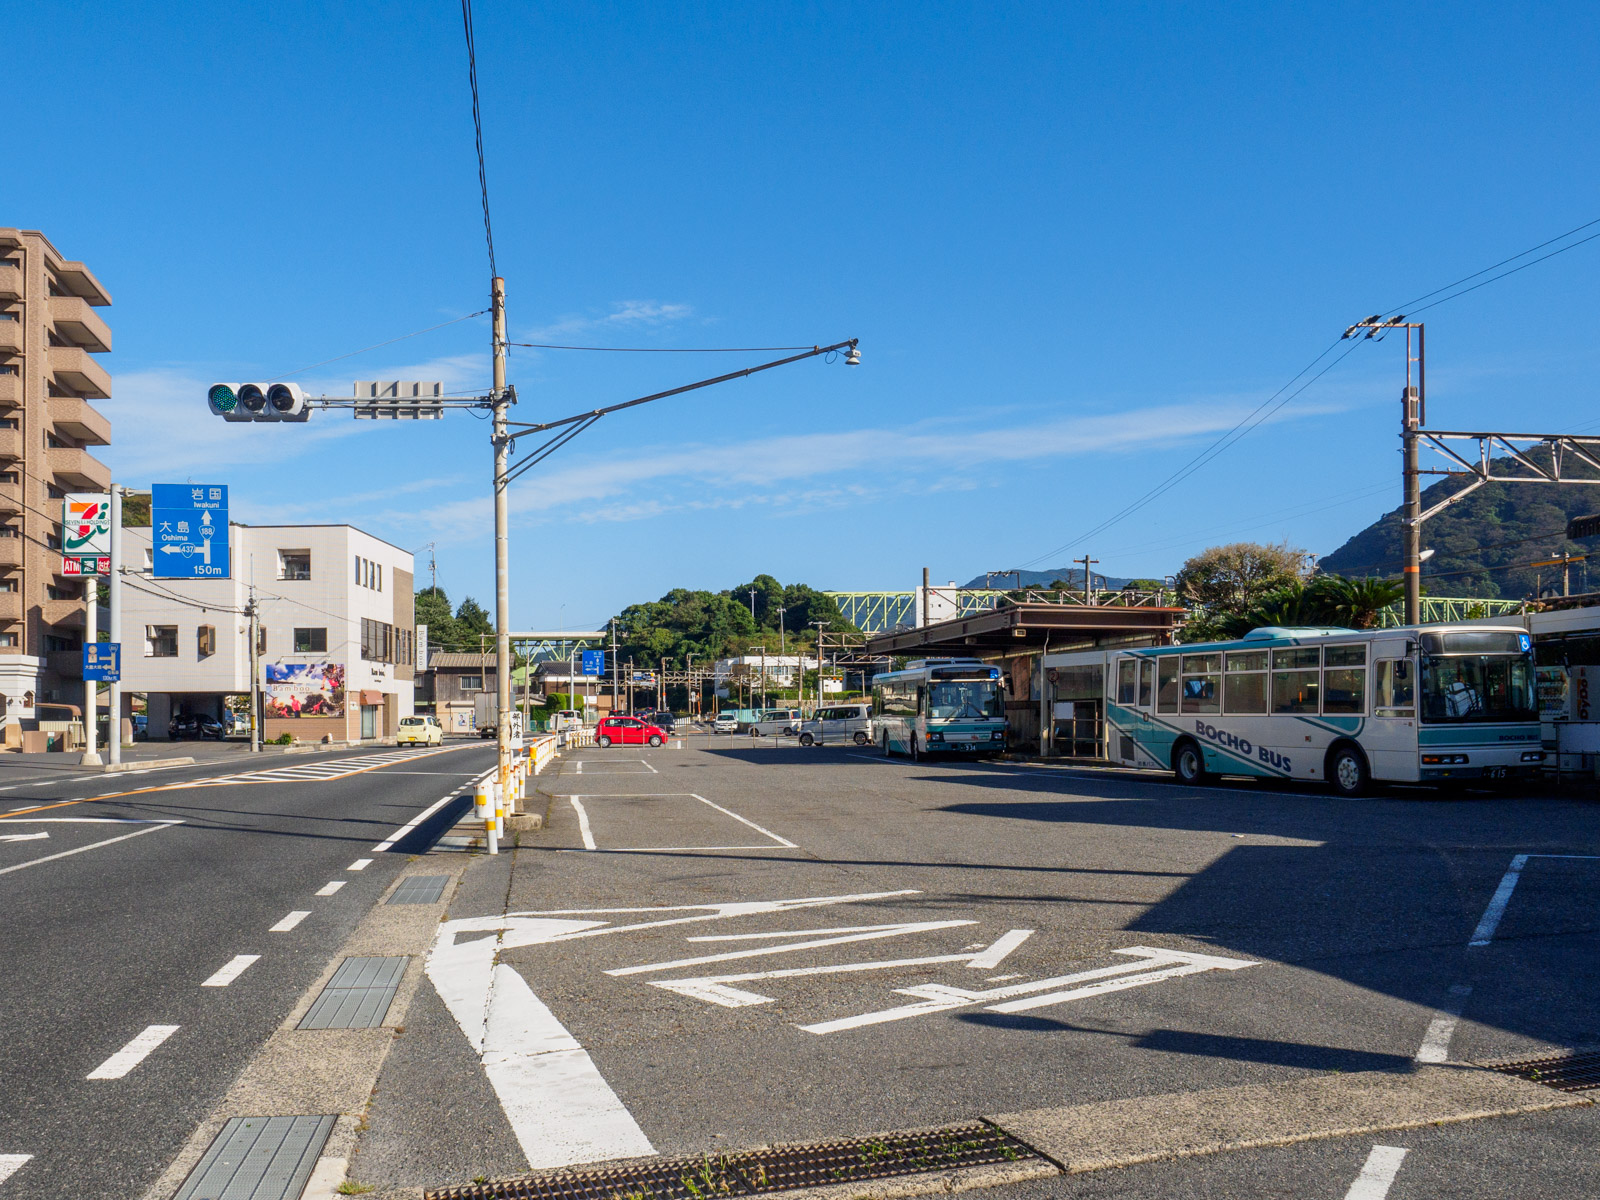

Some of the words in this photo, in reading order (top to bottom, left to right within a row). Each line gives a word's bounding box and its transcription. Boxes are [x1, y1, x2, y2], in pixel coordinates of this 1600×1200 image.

[191, 488, 221, 500] 岩国
[193, 501, 220, 509] Iwakuni
[159, 521, 189, 533] 大島
[64, 560, 80, 572] ATM
[193, 565, 222, 575] 150m
[1580, 679, 1590, 719] DyDo
[1196, 720, 1253, 755] BOCHO
[1258, 746, 1292, 773] BUS
